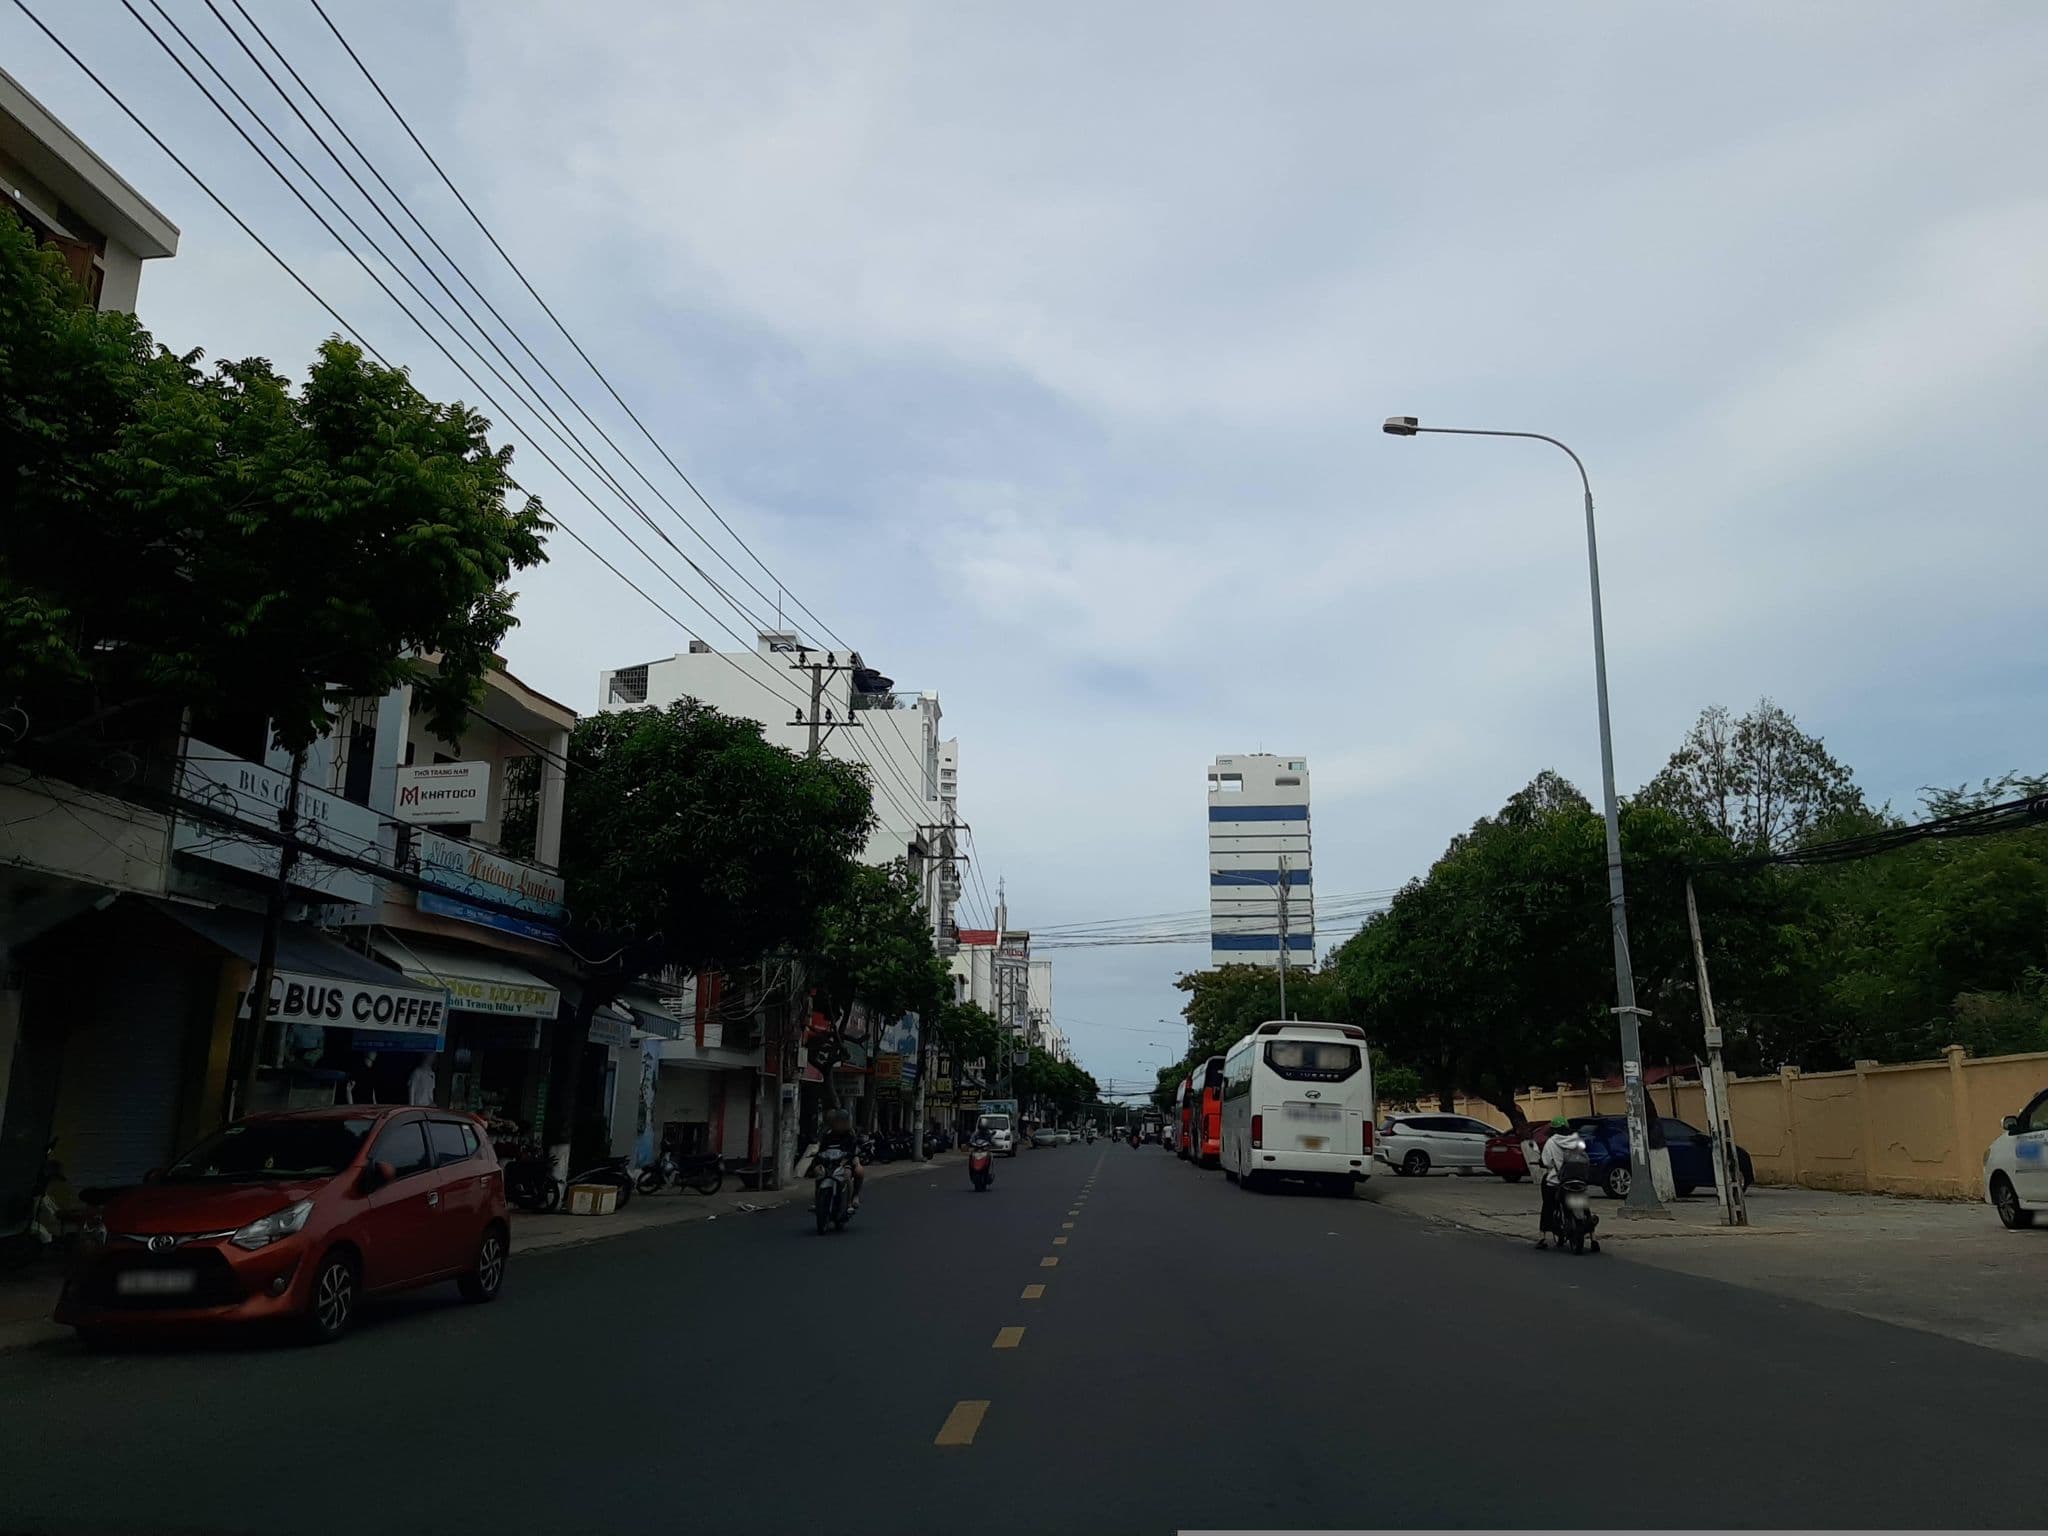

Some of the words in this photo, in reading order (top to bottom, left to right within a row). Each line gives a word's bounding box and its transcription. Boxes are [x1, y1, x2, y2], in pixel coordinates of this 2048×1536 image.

[239, 769, 269, 798] BUS
[421, 788, 476, 800] KHATOCO
[283, 982, 344, 1021] BUS
[352, 992, 443, 1028] COFFEE
